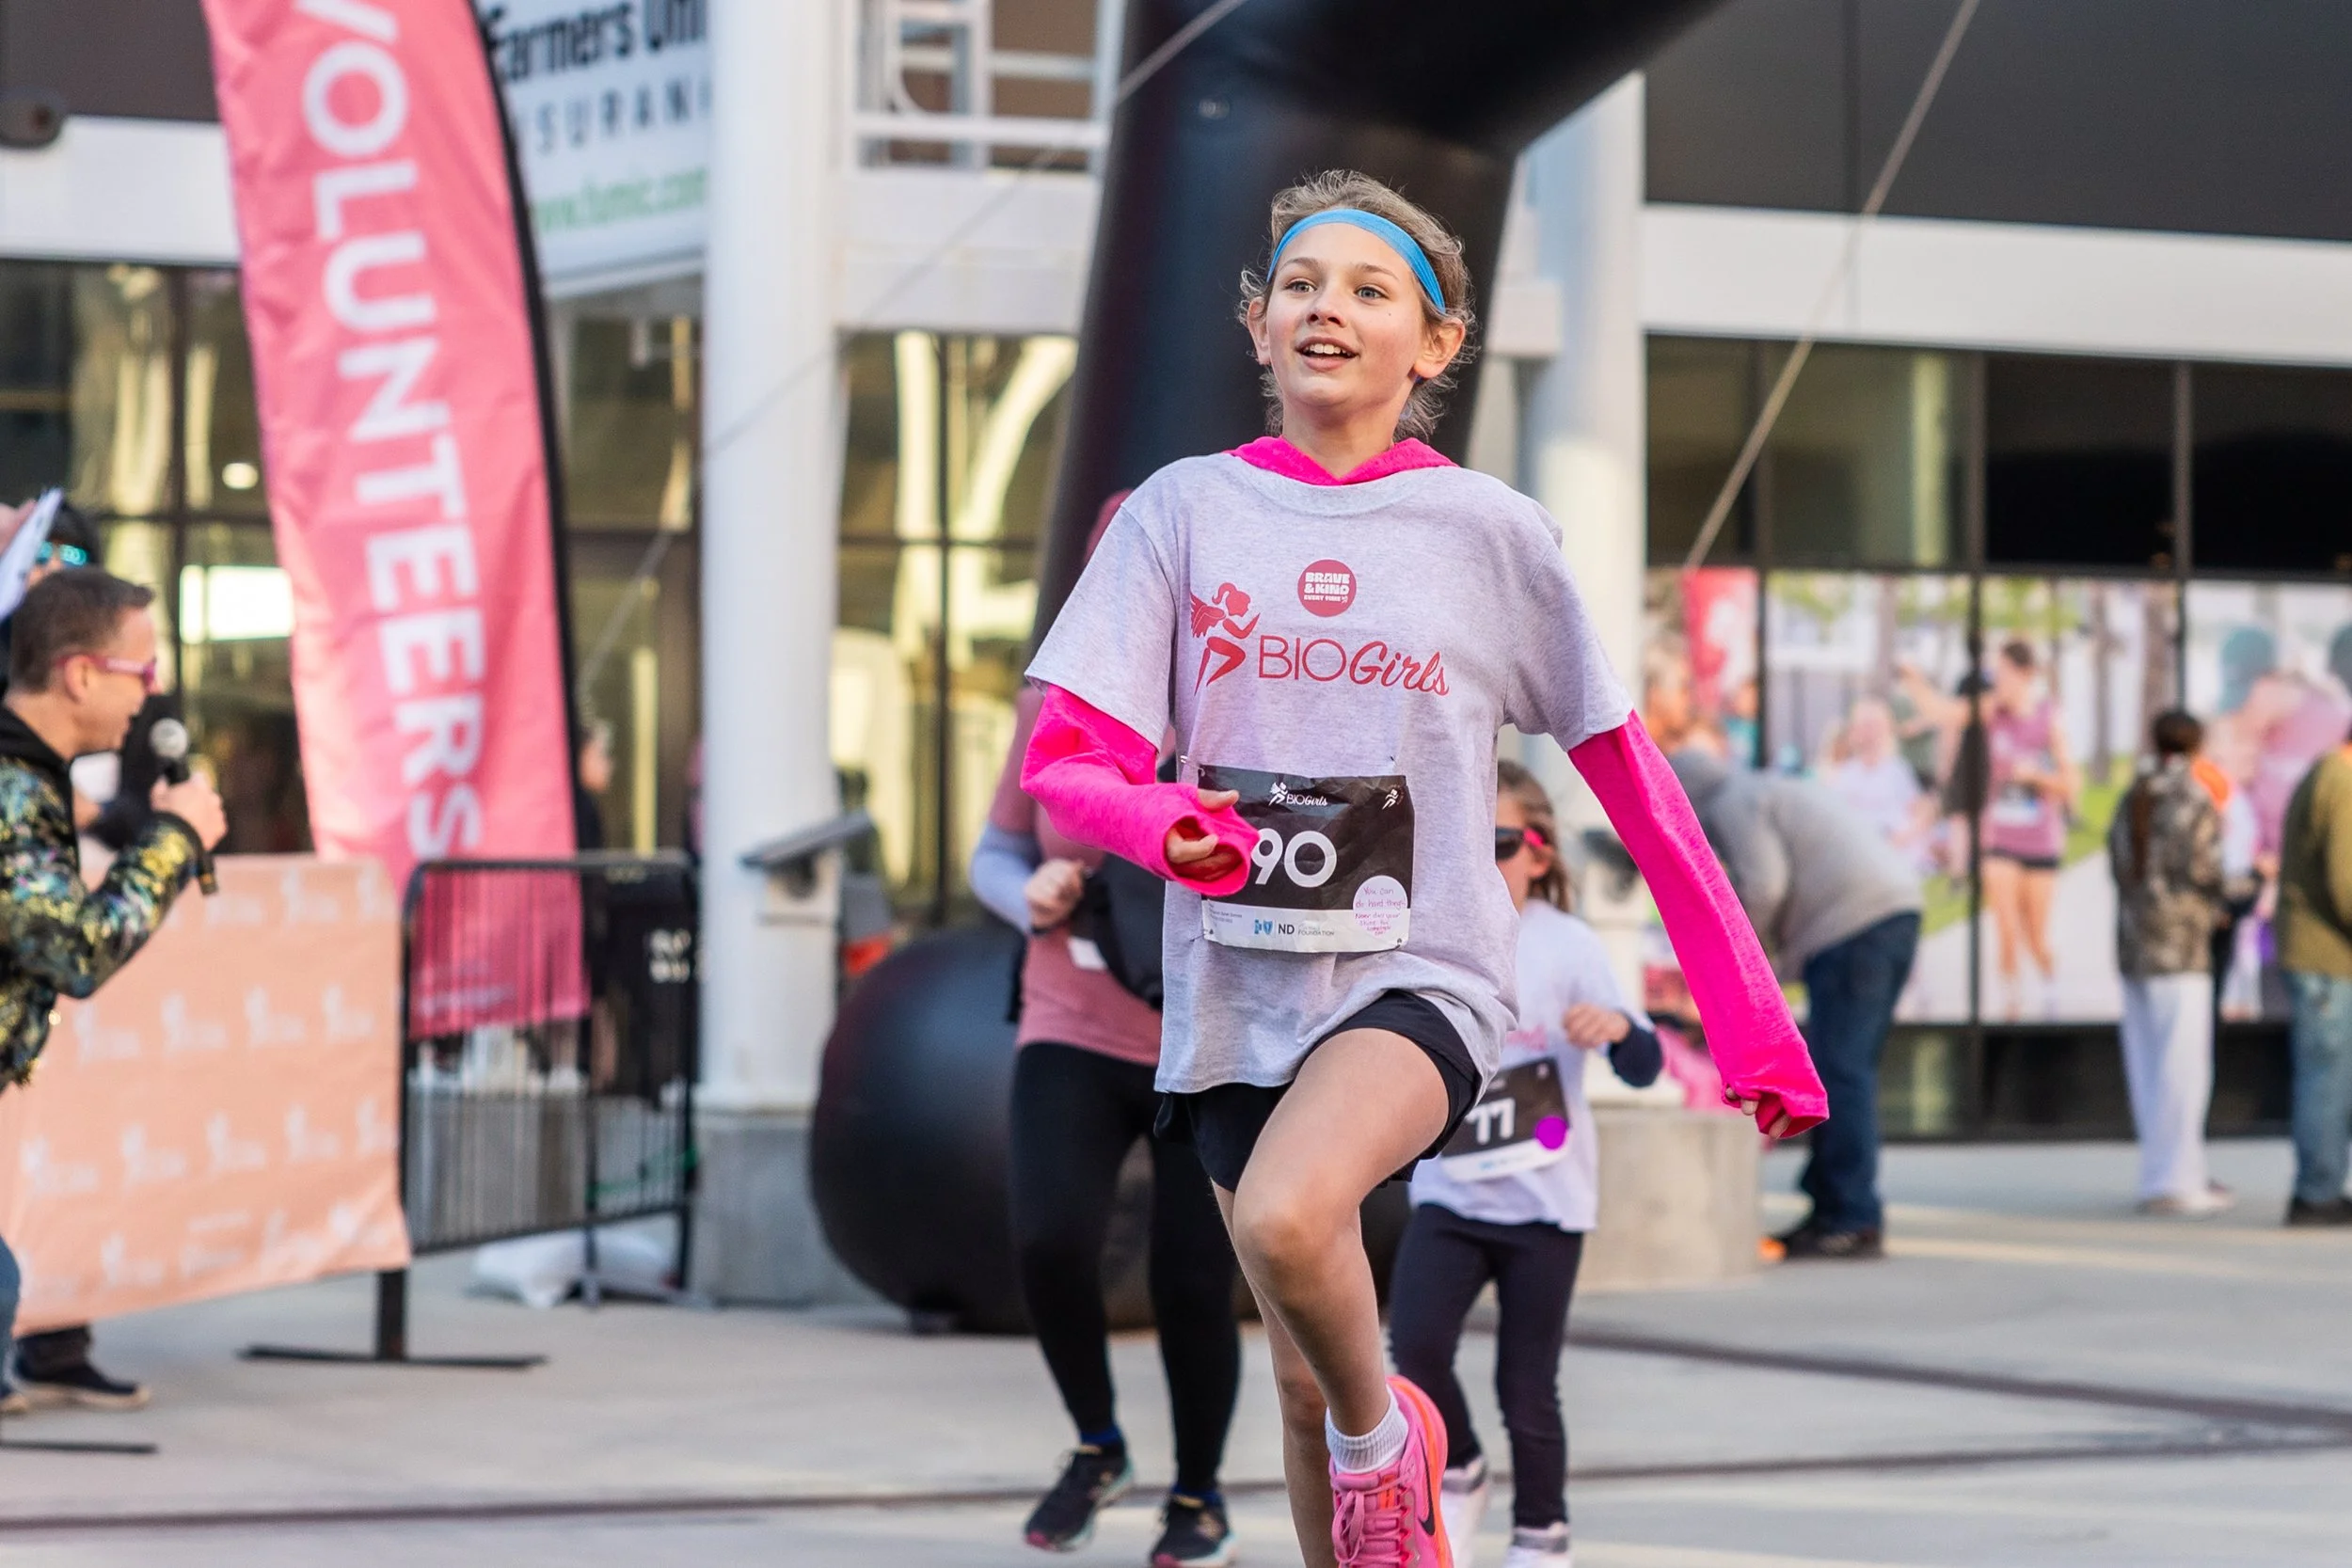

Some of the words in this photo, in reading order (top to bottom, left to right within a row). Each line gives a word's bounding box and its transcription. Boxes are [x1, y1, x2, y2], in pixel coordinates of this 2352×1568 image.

[533, 75, 712, 155] SURAN
[1305, 572, 1350, 584] BRAVE
[1304, 583, 1314, 594] &
[1315, 584, 1349, 594] KIND
[1259, 635, 1449, 695] BIOGirls
[1286, 793, 1327, 807] BIOGirls
[1250, 828, 1337, 888] 90
[1369, 898, 1383, 907] hard
[1279, 924, 1295, 934] ND
[1298, 927, 1334, 936] FOUNDATION
